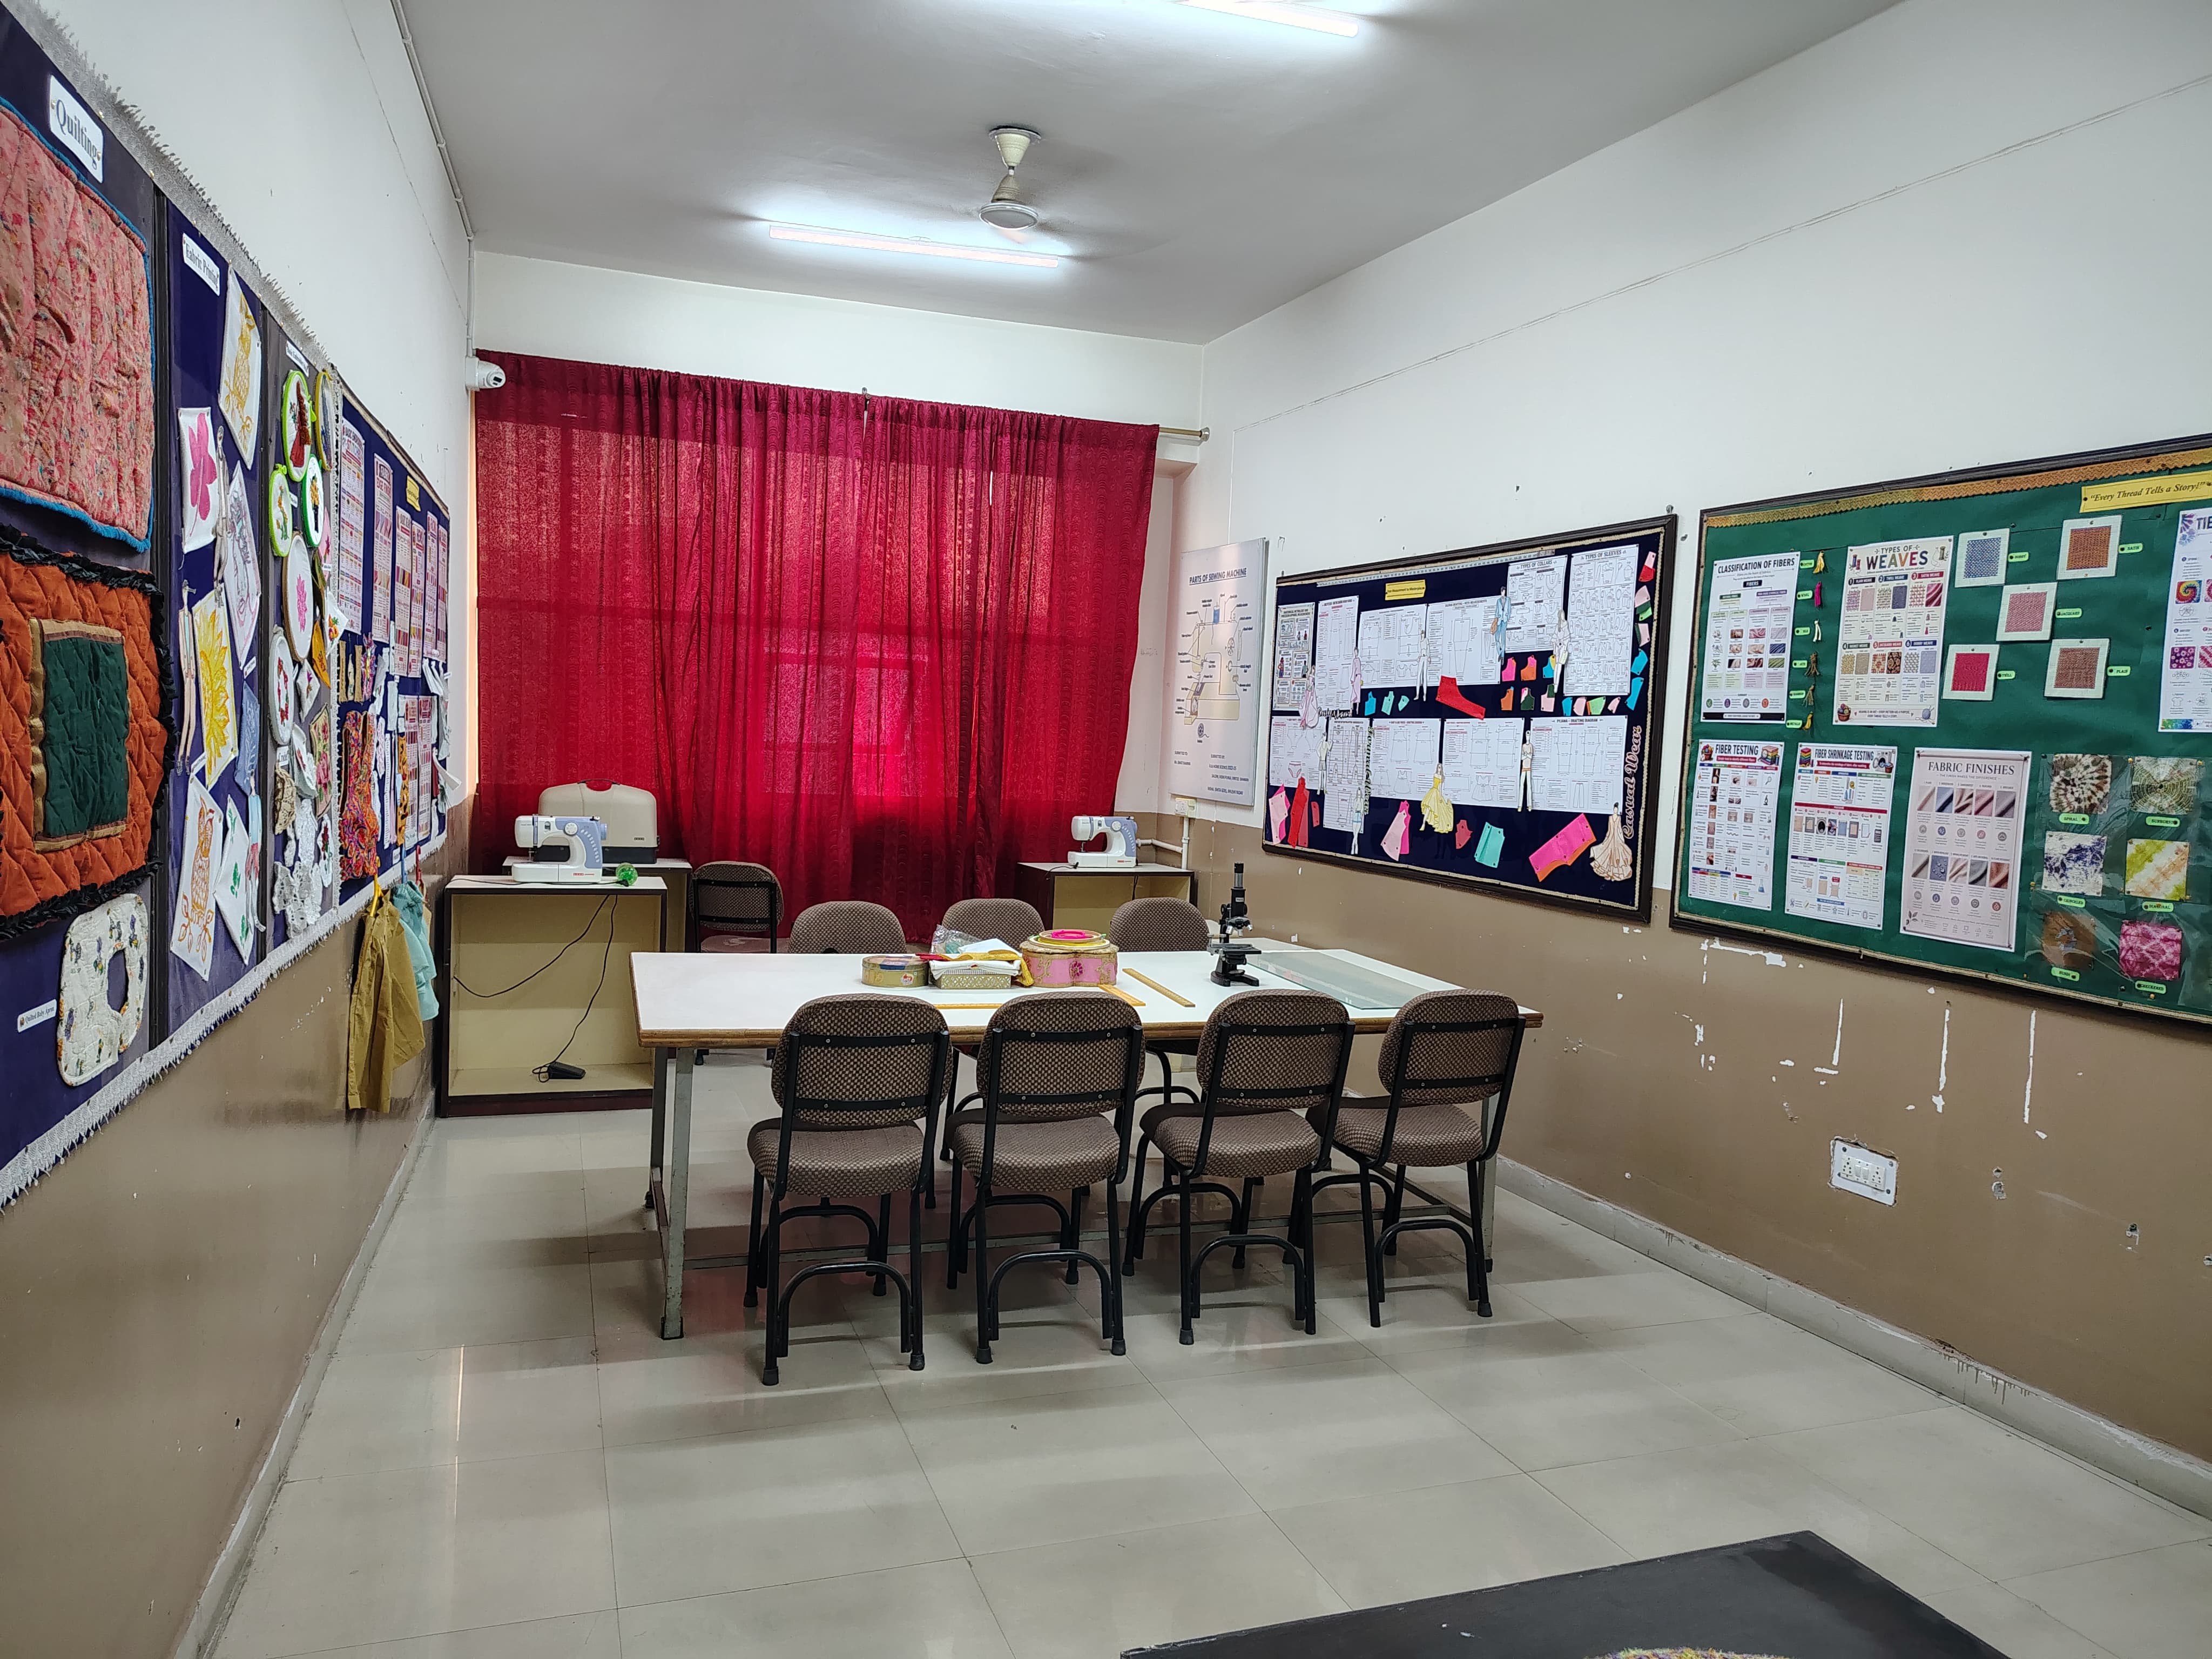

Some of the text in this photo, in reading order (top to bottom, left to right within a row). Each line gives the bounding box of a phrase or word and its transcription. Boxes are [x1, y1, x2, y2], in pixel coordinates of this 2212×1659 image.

[56, 99, 98, 170] Quilting
[2117, 488, 2143, 498] Thread
[2145, 485, 2164, 495] Tells
[1718, 558, 1795, 574] CLASSIFICATION OF FIBERS
[1866, 550, 1928, 570] WEAVES
[1189, 576, 1202, 584] PARTS
[1209, 571, 1225, 581] SEWING
[1226, 568, 1246, 578] MACHINE
[1715, 744, 1759, 755] FIBER TESTING
[1815, 748, 1874, 761] FIBER SHRINKAGE TESTING
[1928, 761, 2015, 775] FABRIC FINISHES
[1622, 725, 1642, 839] Casual Wear
